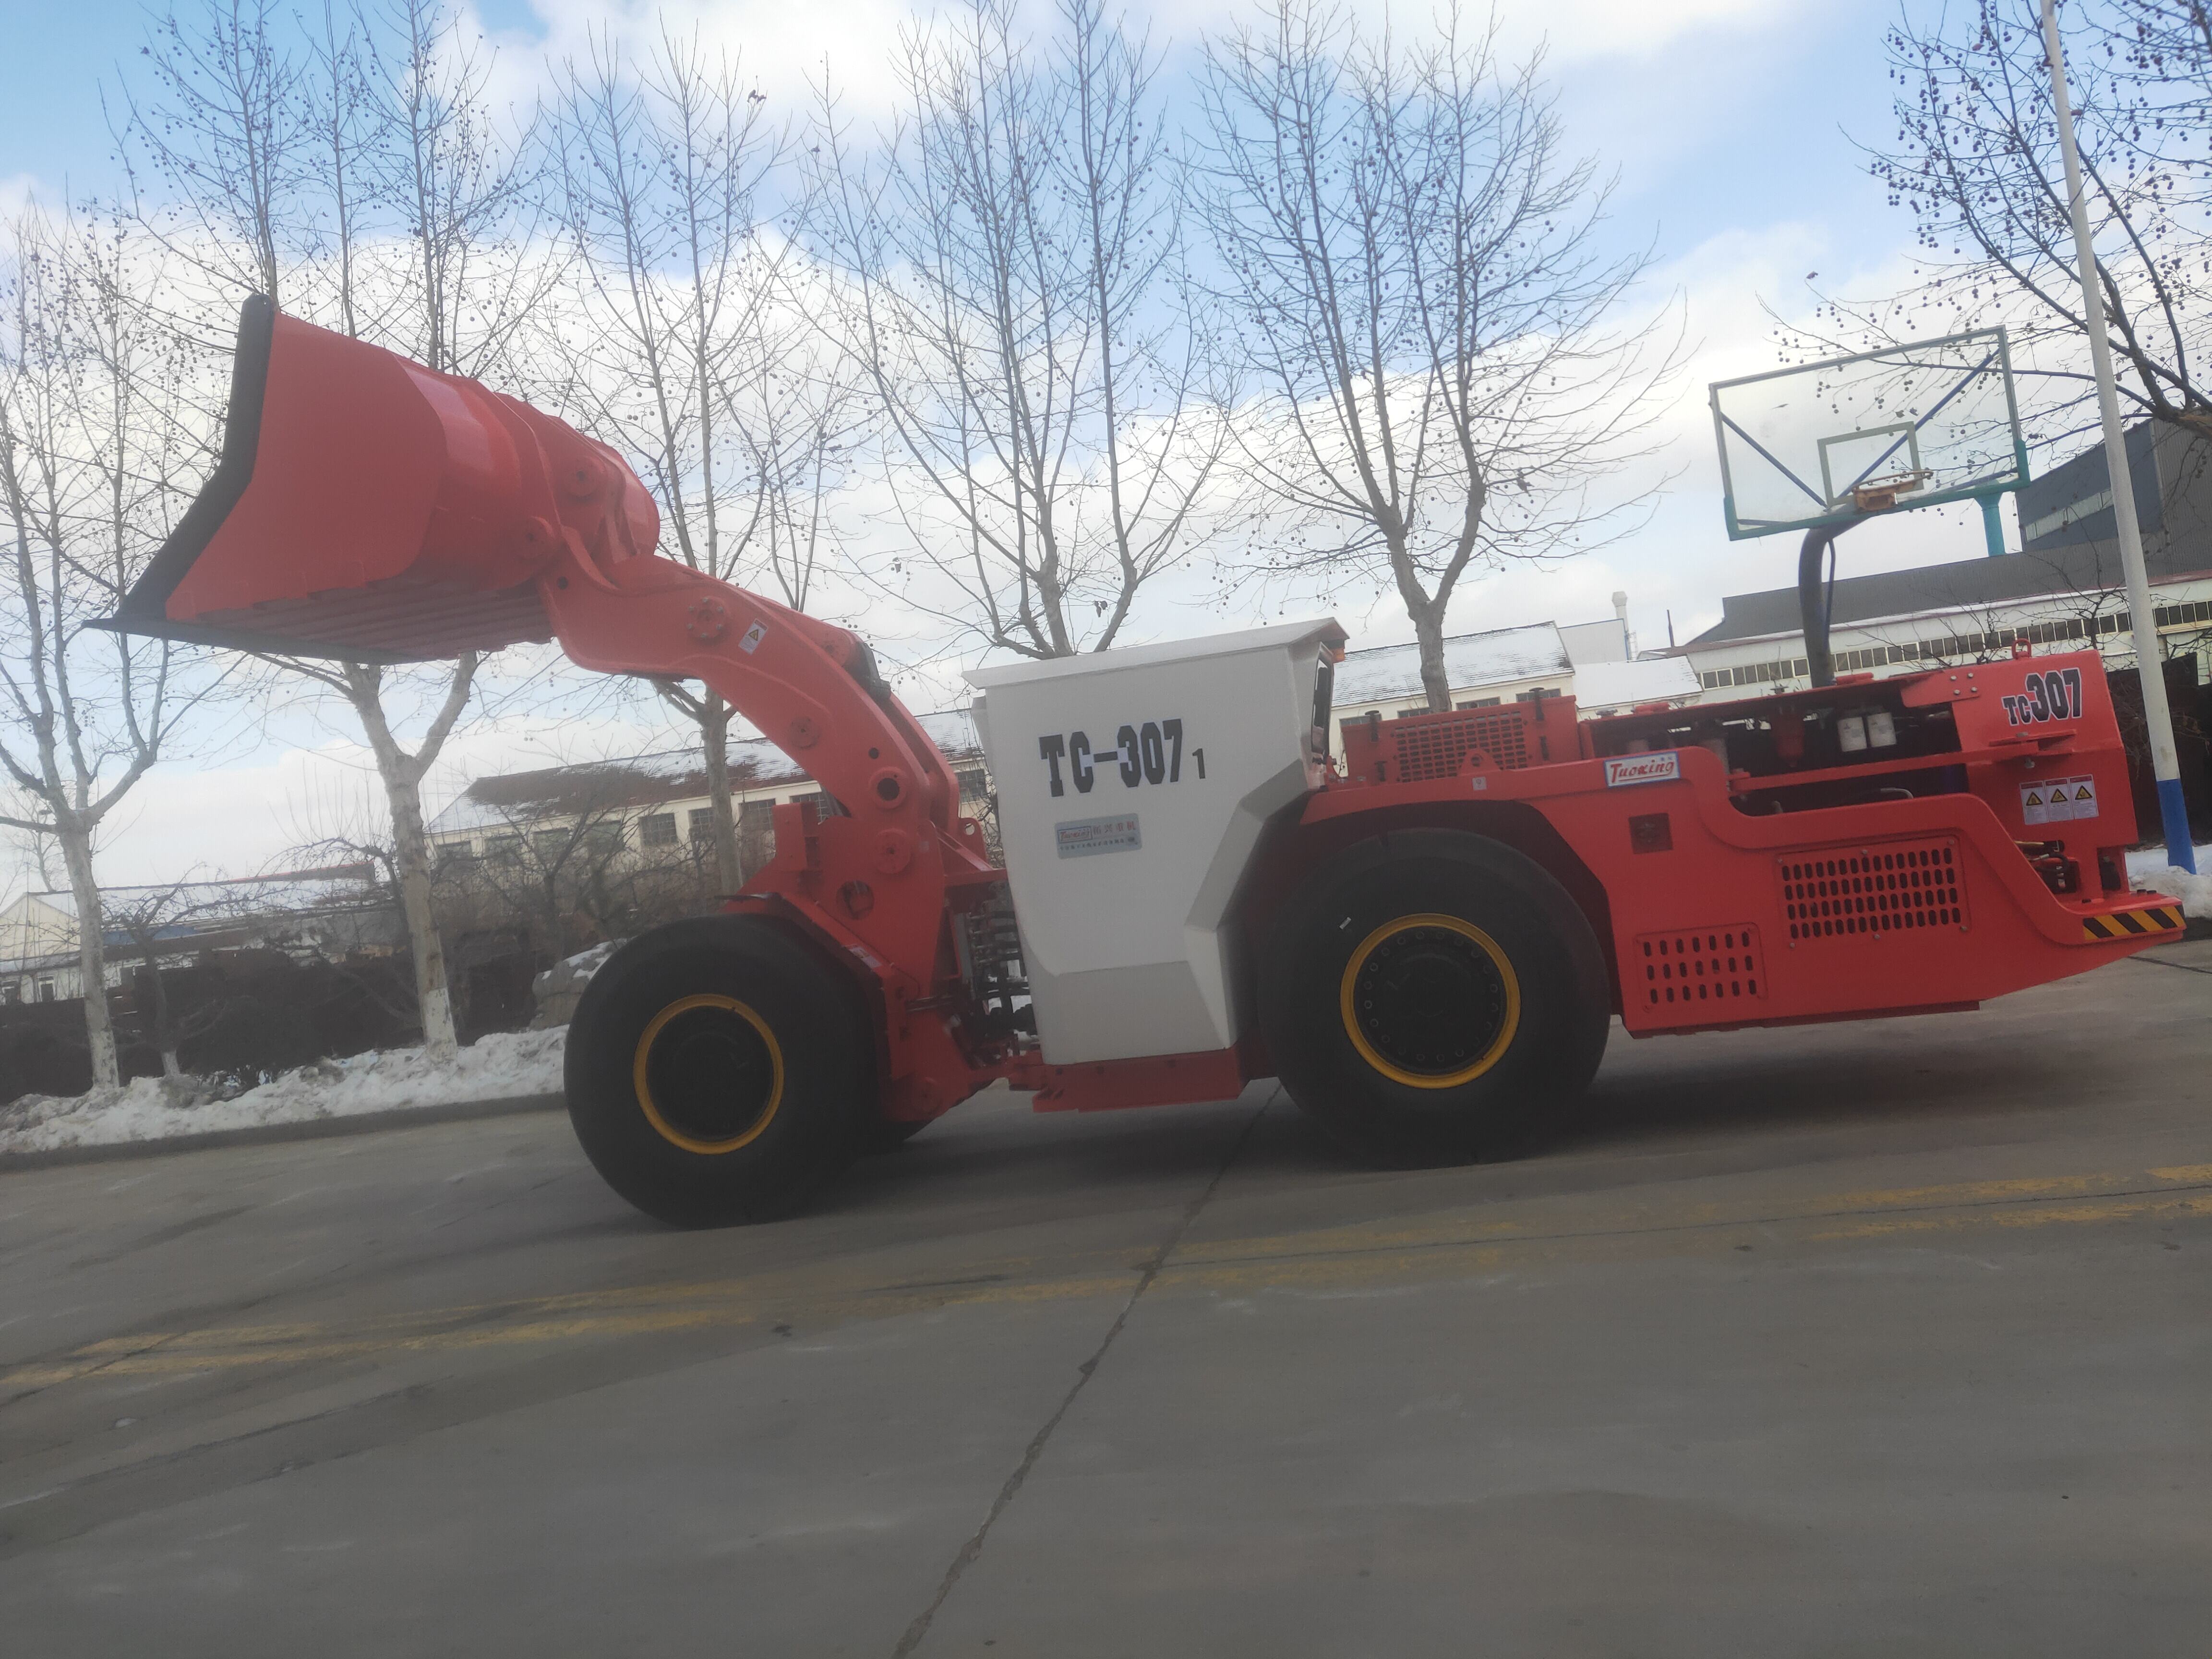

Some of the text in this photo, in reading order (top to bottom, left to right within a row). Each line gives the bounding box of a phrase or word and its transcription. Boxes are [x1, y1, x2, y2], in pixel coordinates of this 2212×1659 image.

[2001, 668, 2082, 726] TC307
[1039, 719, 1206, 797] TC-307 1
[1611, 759, 1674, 783] Tuoxing
